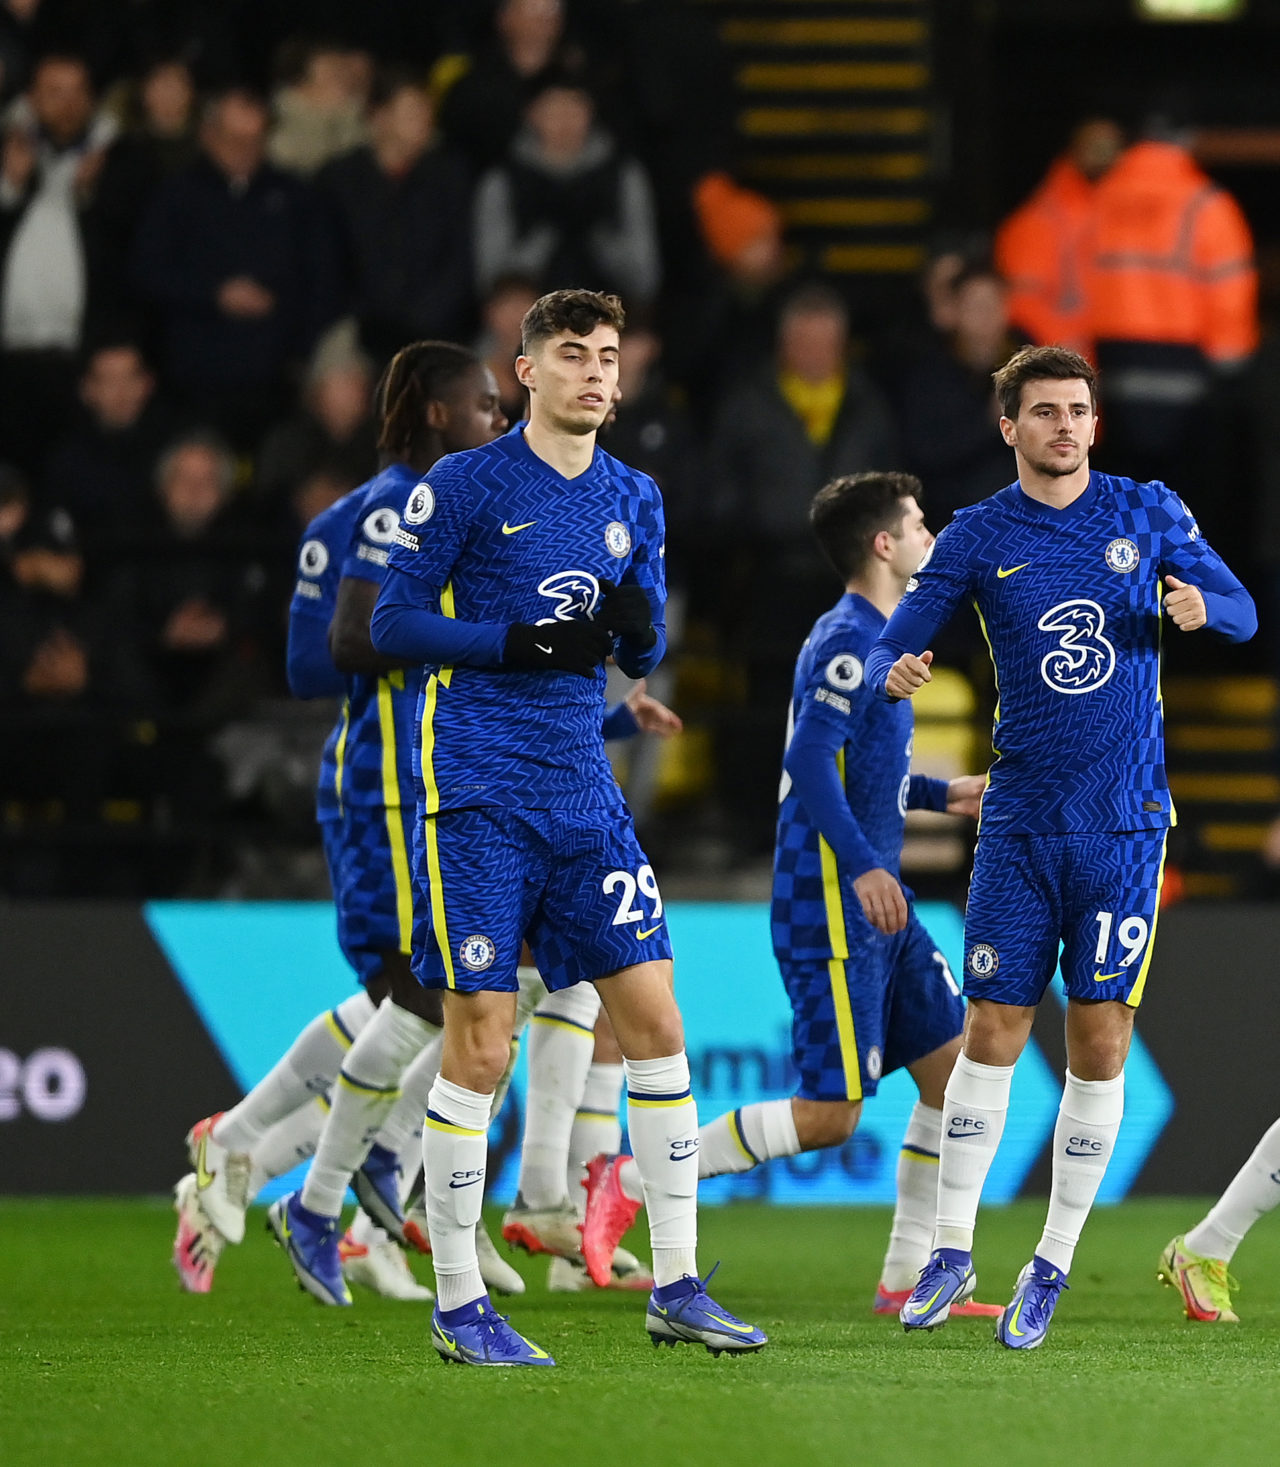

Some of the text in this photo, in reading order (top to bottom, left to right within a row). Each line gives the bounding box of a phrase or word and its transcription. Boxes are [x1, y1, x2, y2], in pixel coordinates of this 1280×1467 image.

[1038, 599, 1116, 694] 3
[603, 864, 663, 926] 29
[1095, 911, 1148, 967] 19
[951, 1116, 985, 1130] CFC
[670, 1137, 699, 1150] CFC
[1069, 1136, 1103, 1151] CFC
[451, 1168, 484, 1179] CFC
